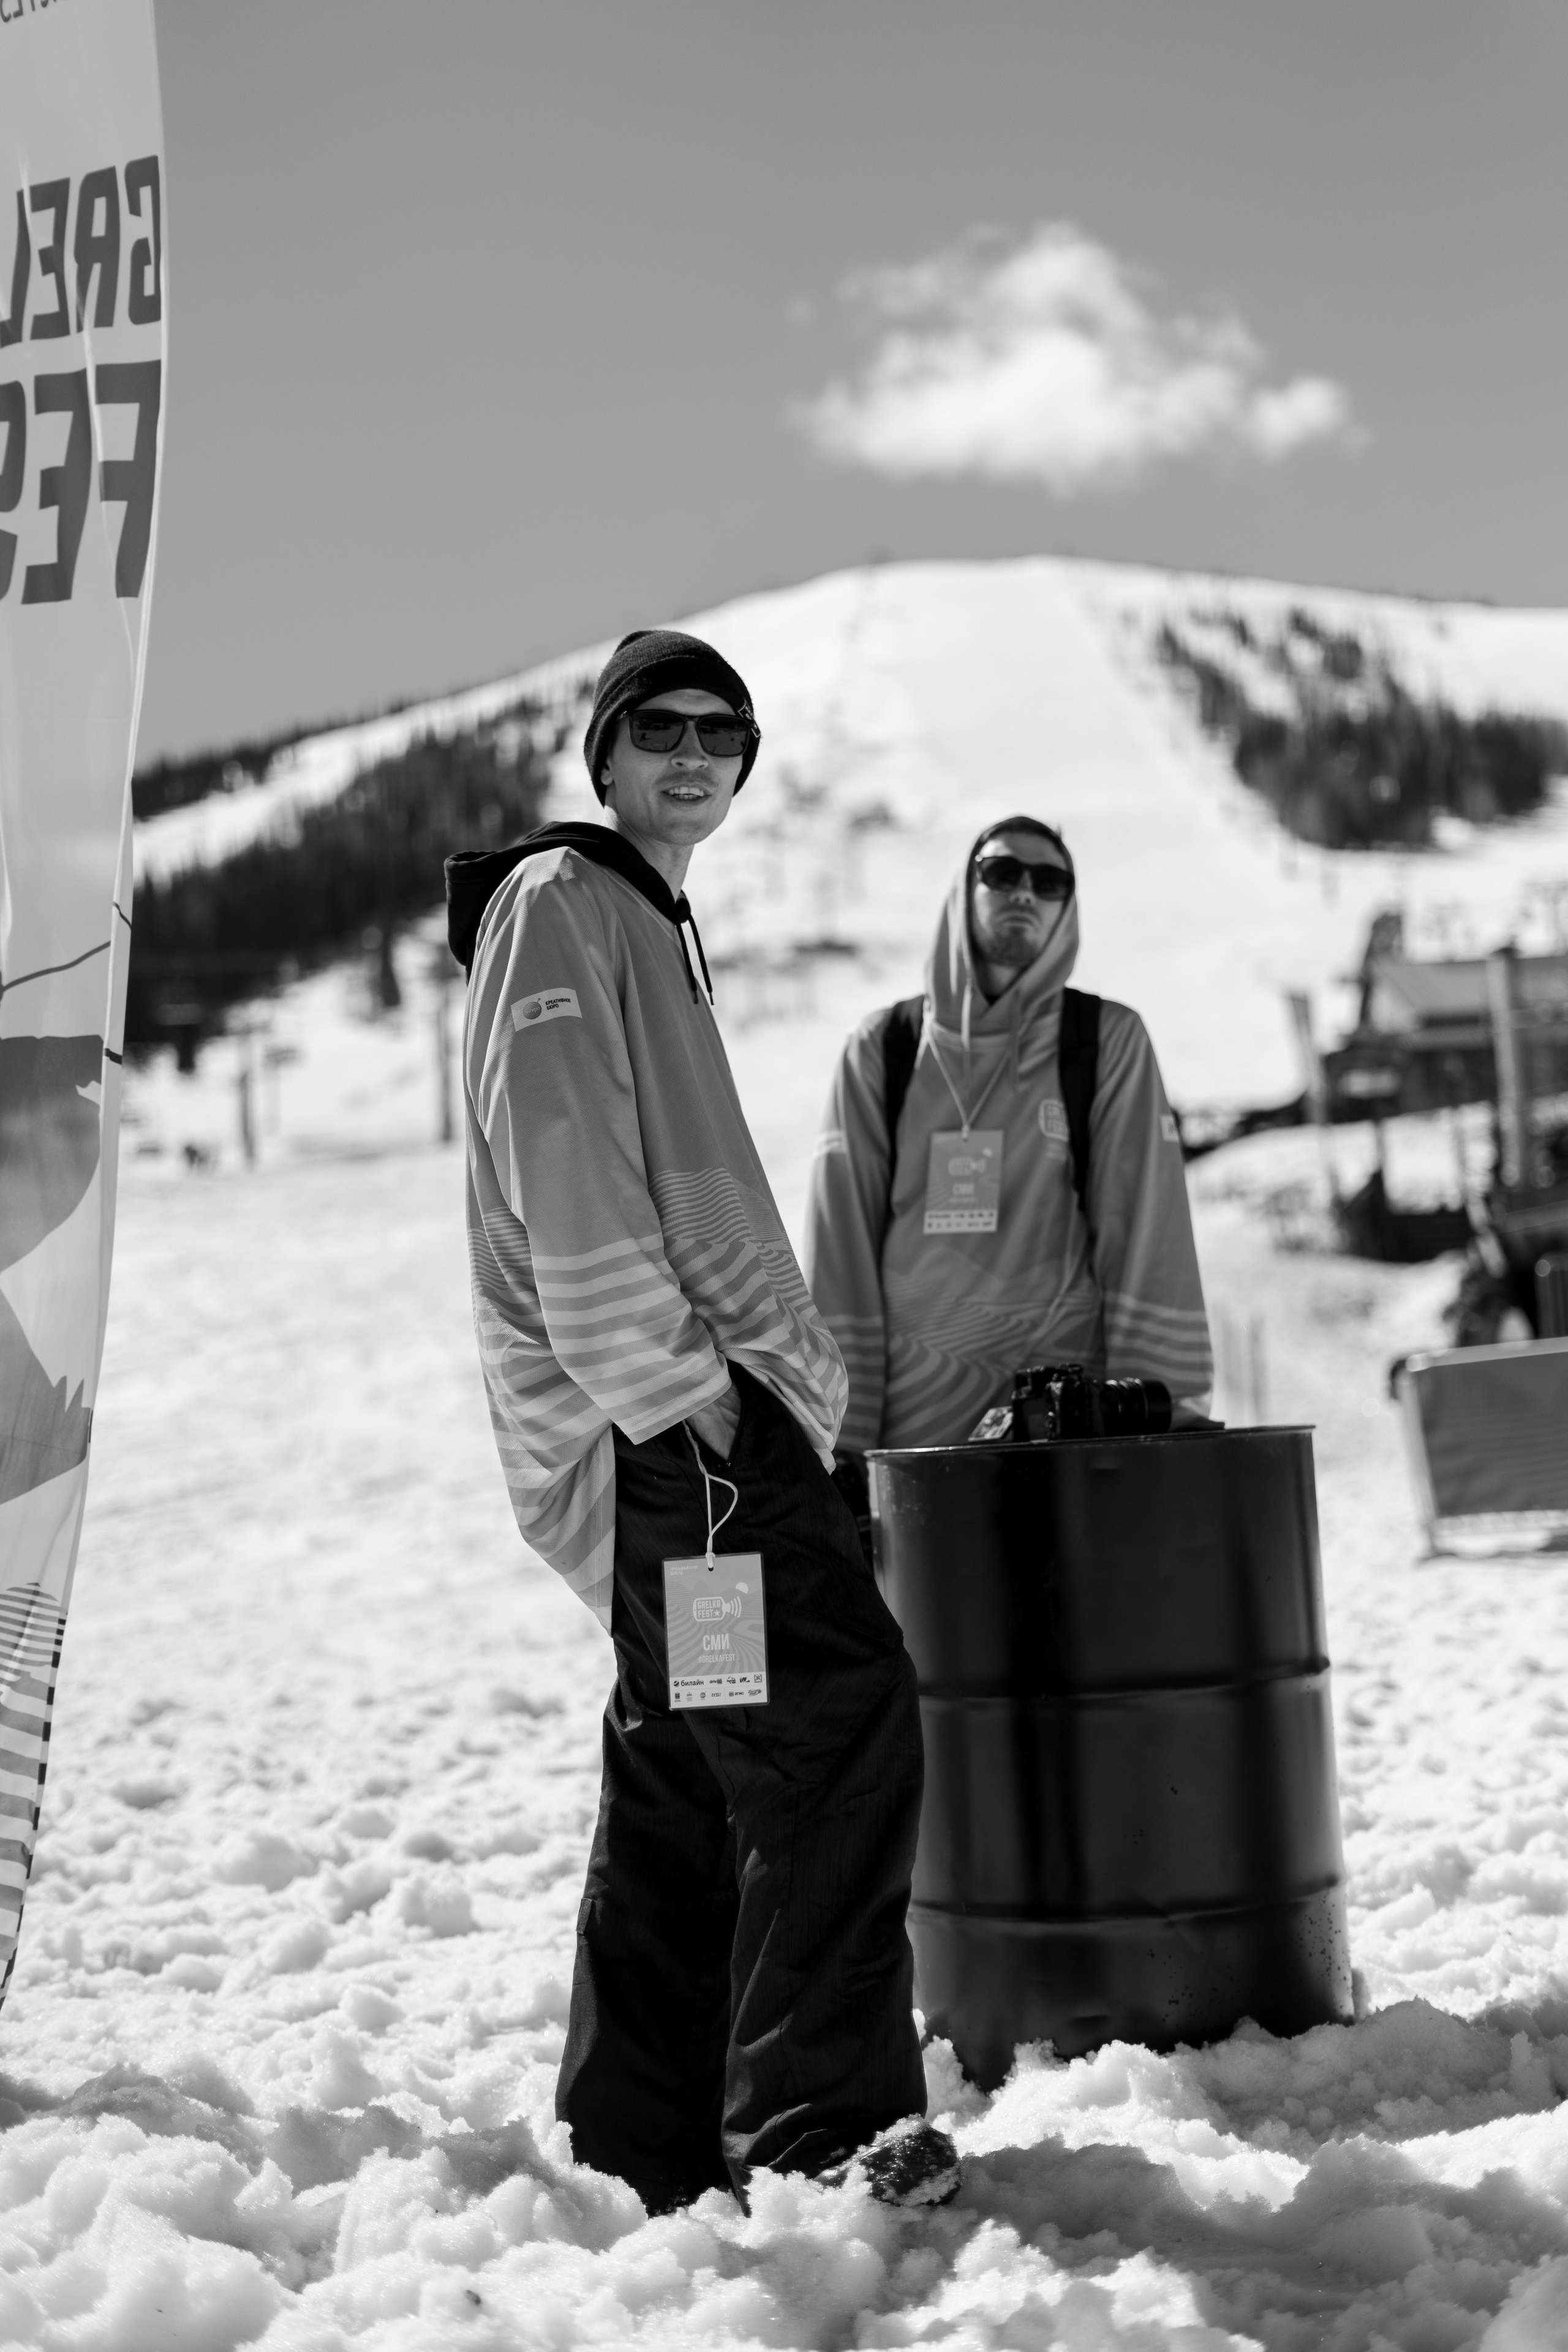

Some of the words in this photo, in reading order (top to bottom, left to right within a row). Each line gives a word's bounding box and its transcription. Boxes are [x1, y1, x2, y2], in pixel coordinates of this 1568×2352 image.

[697, 1600, 721, 1609] GRELKA
[698, 1609, 714, 1618] FEST
[703, 1634, 729, 1651] СМИ
[698, 1653, 736, 1664] #GRELKAFEST
